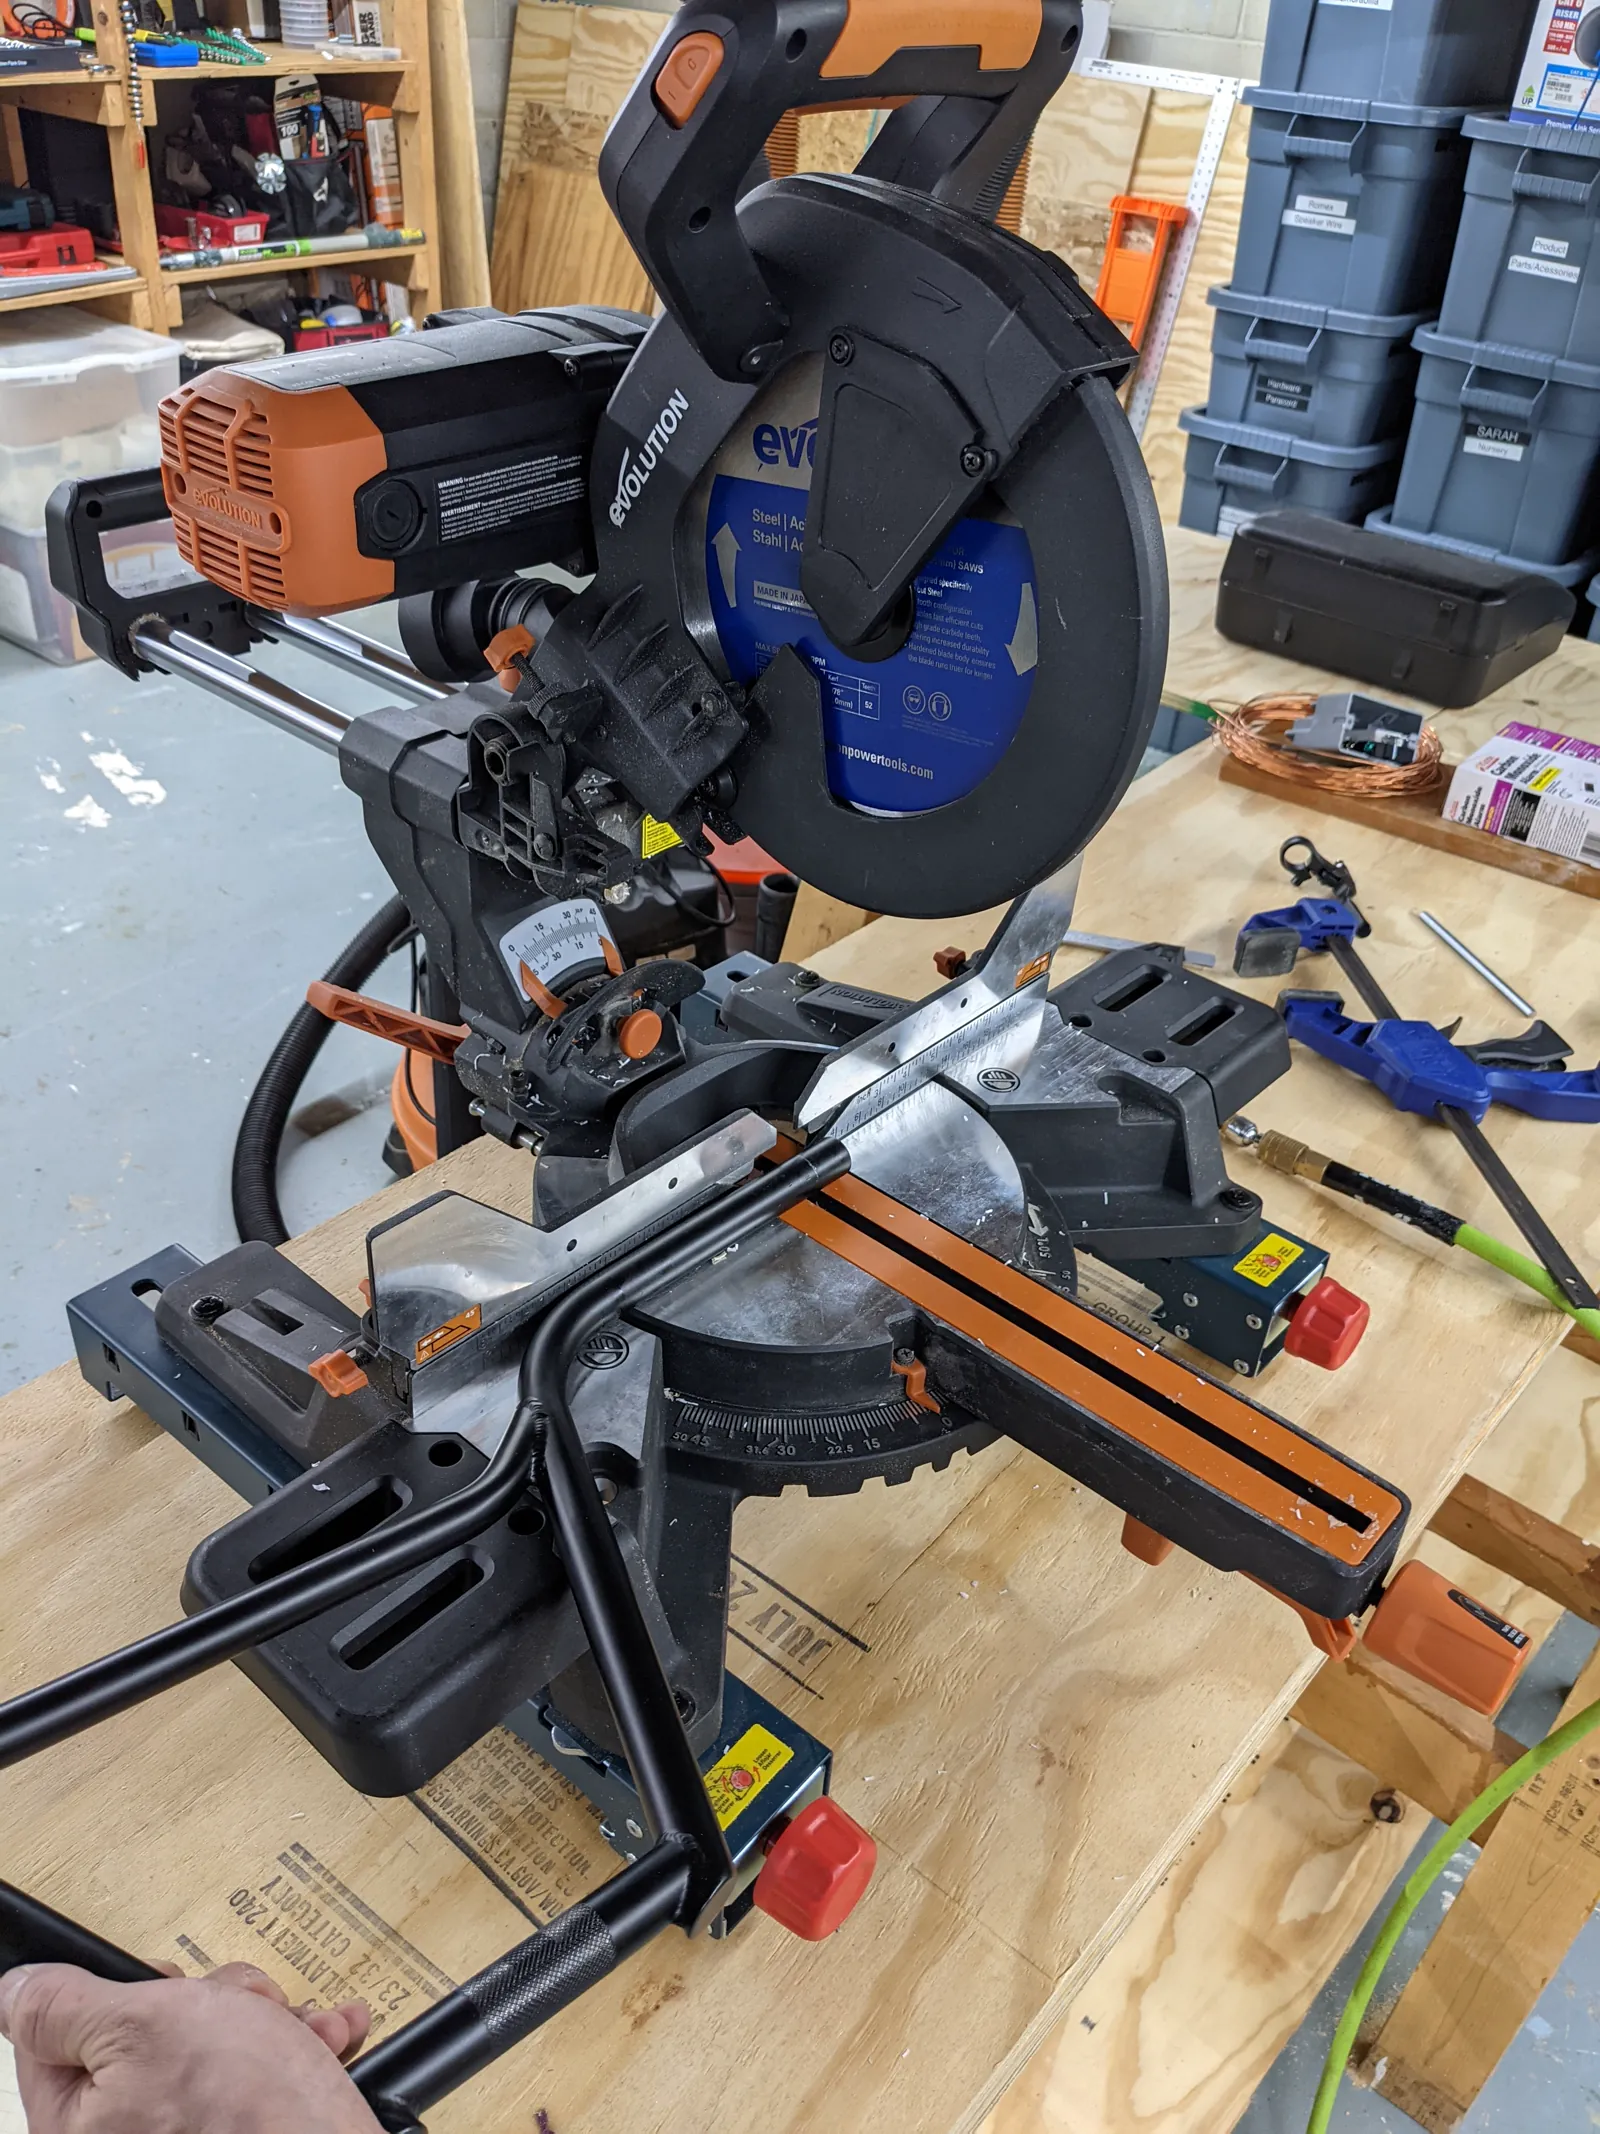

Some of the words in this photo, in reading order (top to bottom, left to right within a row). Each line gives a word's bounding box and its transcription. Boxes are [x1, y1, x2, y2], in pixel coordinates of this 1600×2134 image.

[1555, 8, 1580, 20] RISER
[1521, 97, 1534, 106] UP
[280, 124, 299, 138] 100
[1545, 118, 1572, 130] Premium
[1534, 240, 1567, 255] Product
[1510, 258, 1579, 280] Parts/Acessories
[1476, 424, 1520, 444] SARAH
[437, 476, 464, 489] WARNING
[752, 508, 780, 526] Steel
[753, 529, 781, 548] Stahl
[957, 561, 984, 574] SAWS
[757, 585, 779, 598] MADE
[780, 590, 789, 601] IN
[927, 587, 943, 598] Steel
[938, 578, 973, 593] specifically
[754, 641, 771, 652] MAX
[908, 641, 937, 656] Hardened
[937, 647, 954, 660] blade
[954, 652, 970, 665] body
[857, 682, 877, 692] Teeth
[864, 701, 874, 710] 52
[534, 922, 545, 933] 15
[562, 910, 572, 920] 30
[589, 908, 597, 916] 45
[551, 951, 562, 962] 30
[575, 941, 584, 950] 15
[1093, 1302, 1153, 1336] GROUP
[777, 1444, 797, 1457] 30
[826, 1444, 855, 1455] 22.5
[862, 1437, 882, 1450] 15
[482, 1735, 564, 1812] SAFEGUARDS
[228, 1888, 268, 1925] 240
[258, 1875, 351, 1958] CATEGORY
[348, 1953, 412, 2011] 23/32
